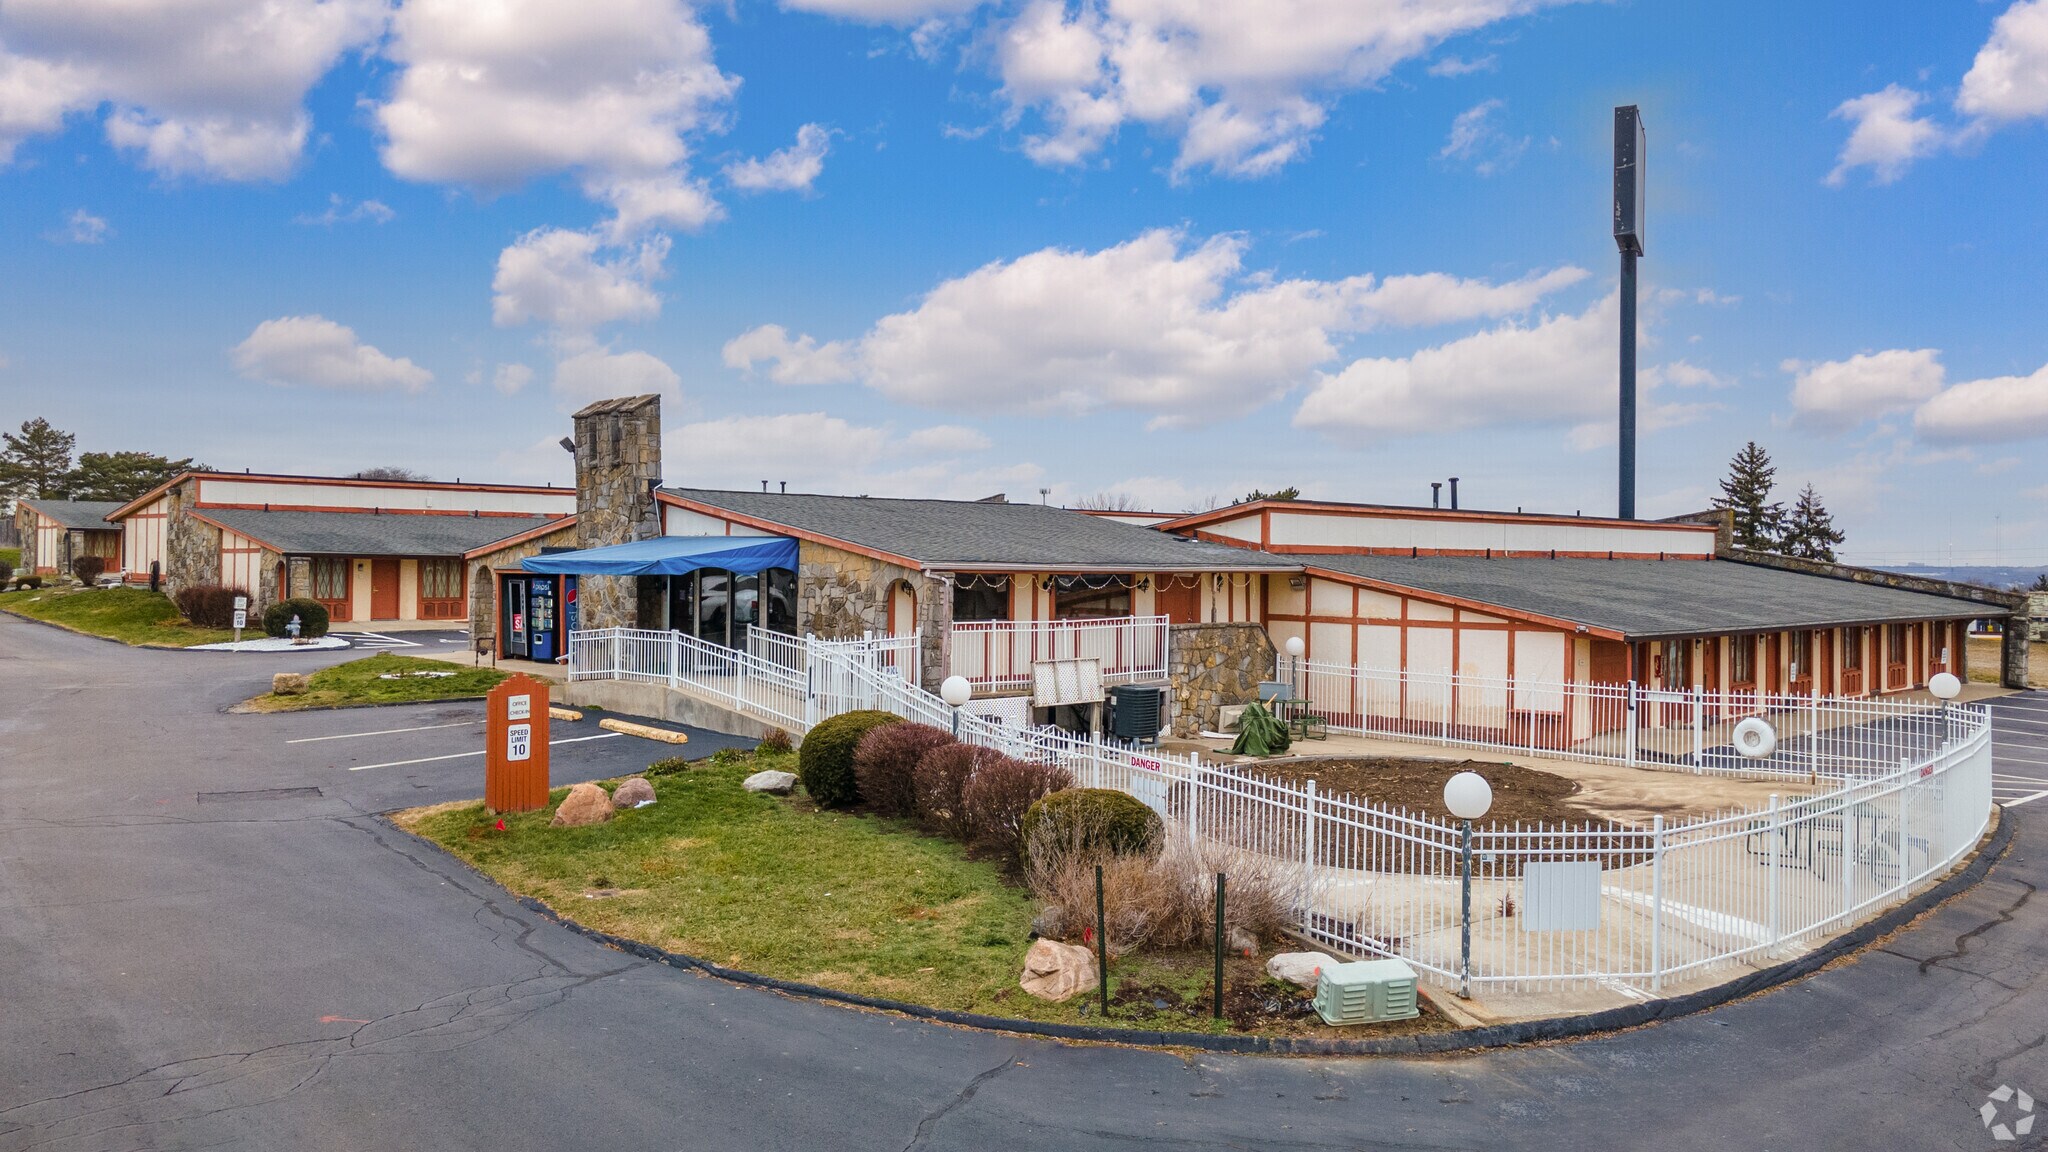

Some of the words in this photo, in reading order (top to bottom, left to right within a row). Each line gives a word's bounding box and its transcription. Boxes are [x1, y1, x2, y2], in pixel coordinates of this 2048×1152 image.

[510, 729, 529, 737] SPEED
[513, 744, 526, 756] 10
[1131, 756, 1161, 772] DANGER
